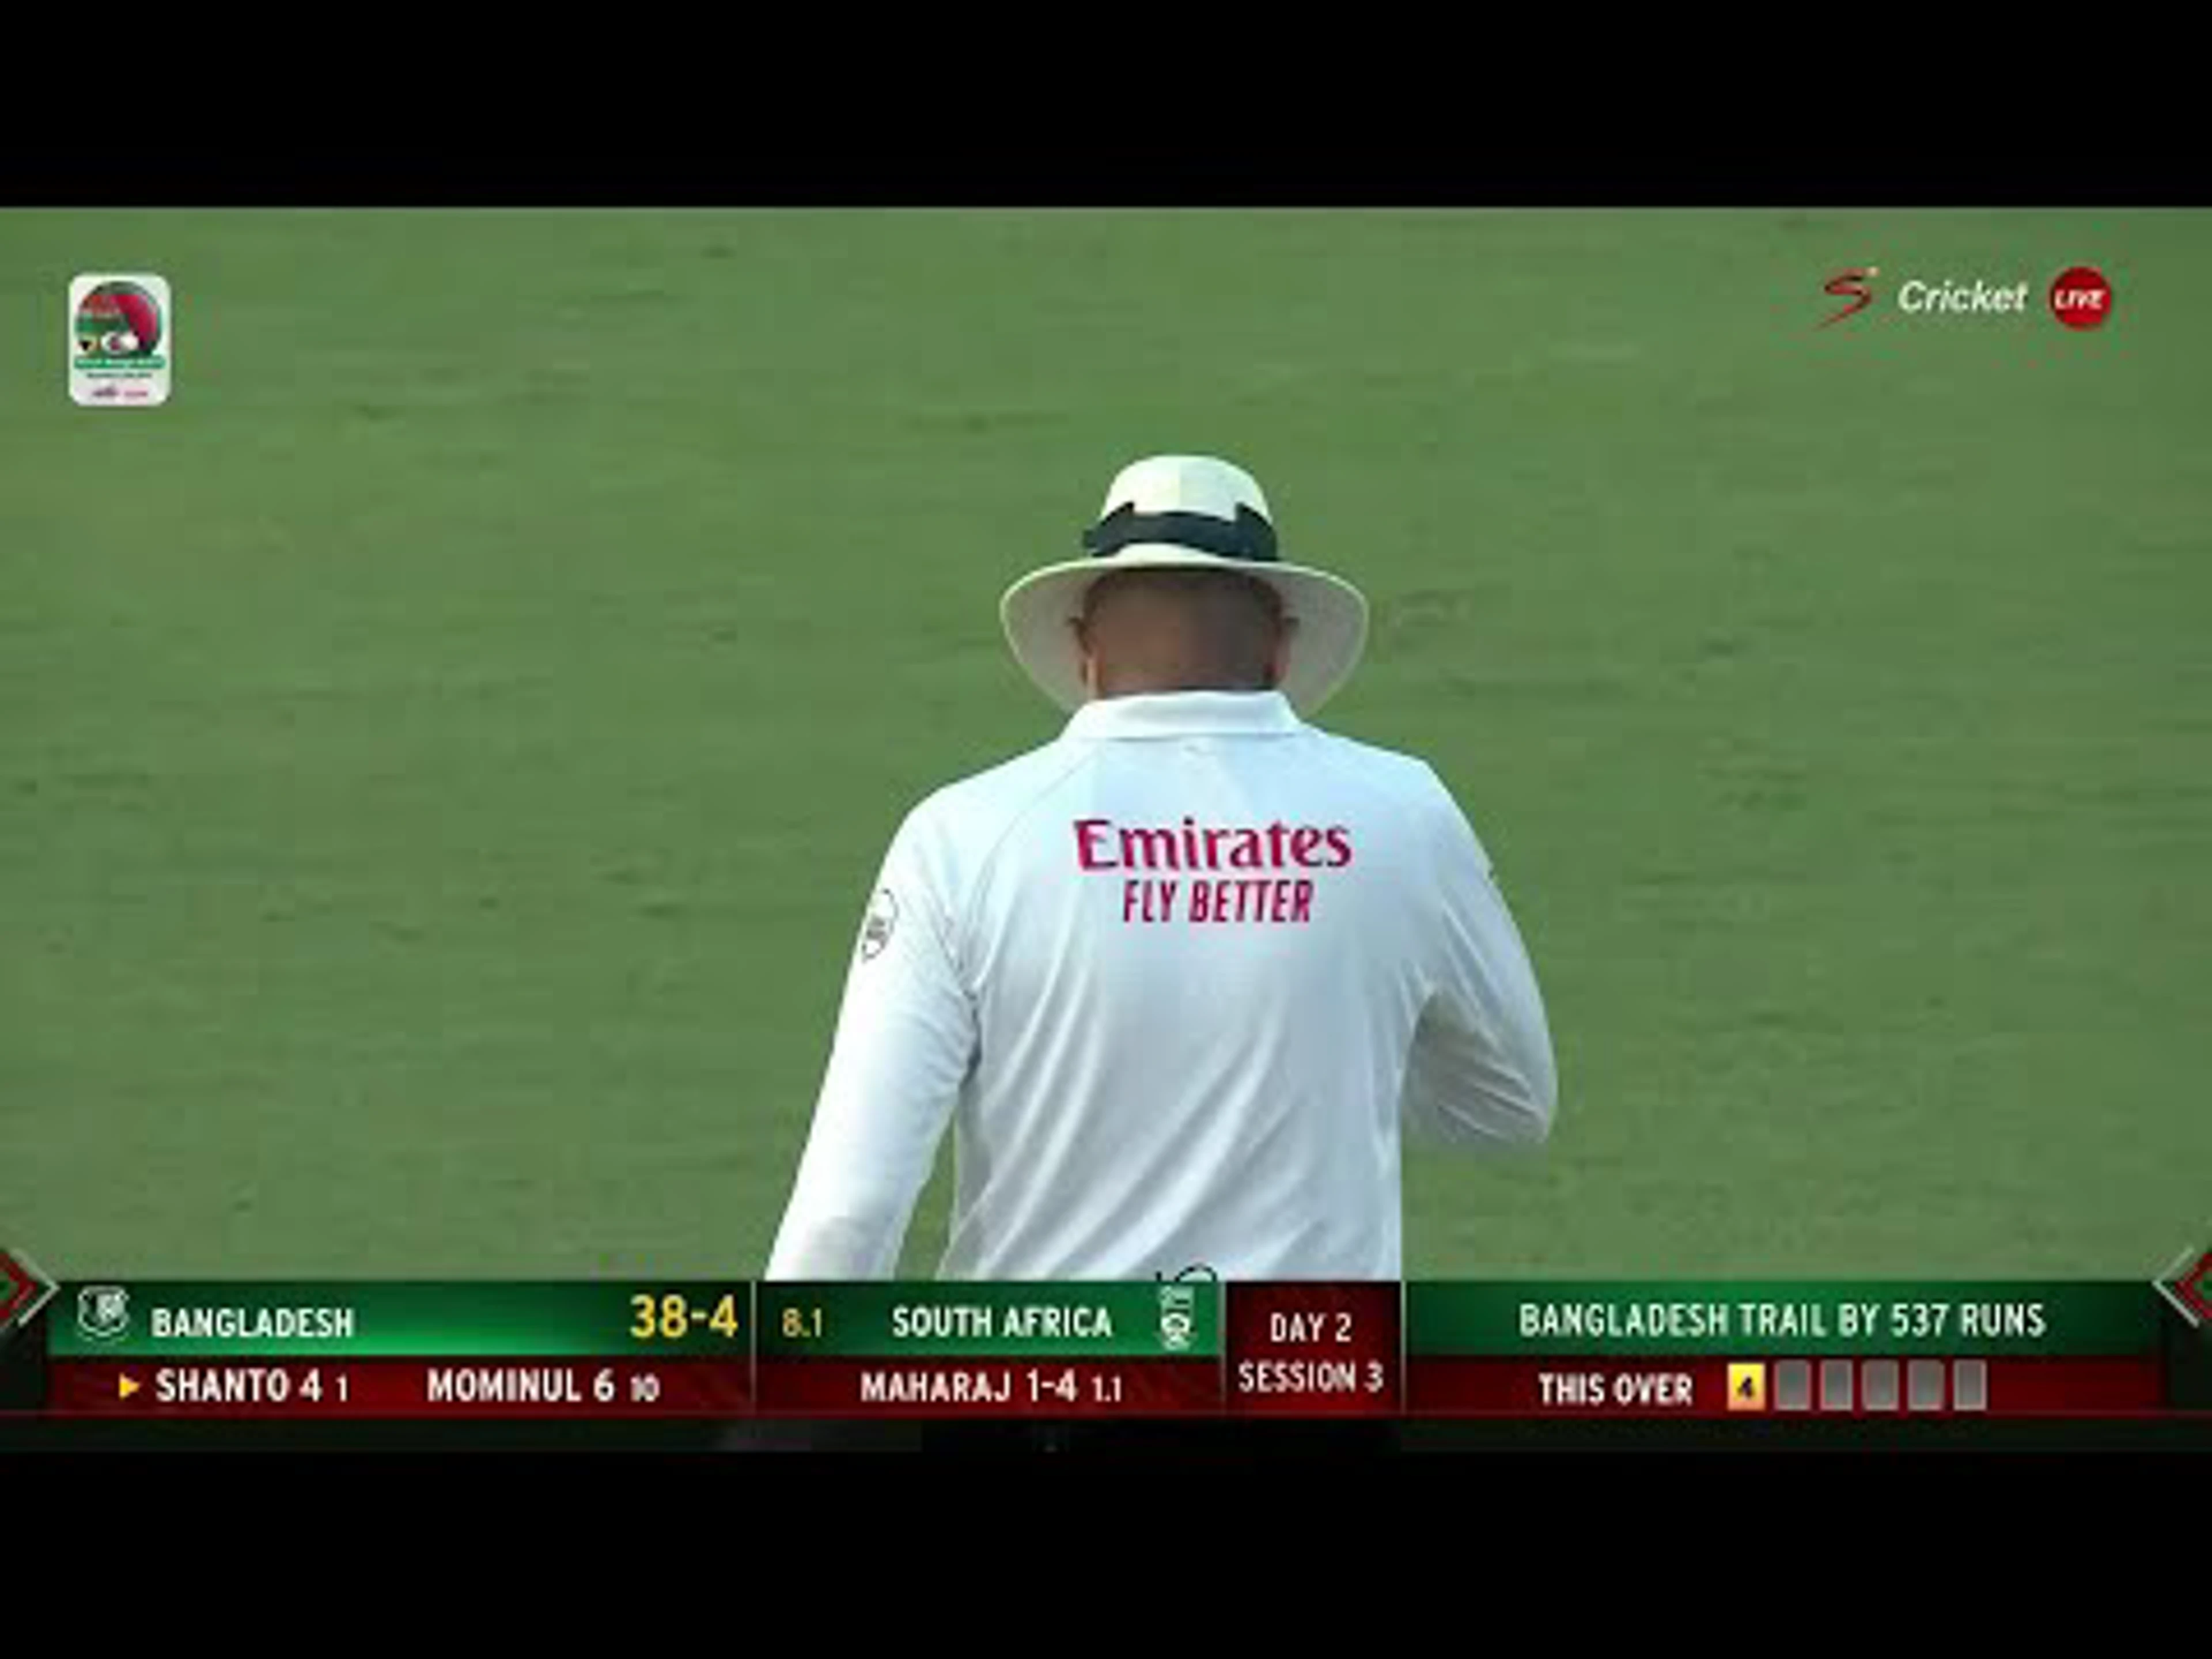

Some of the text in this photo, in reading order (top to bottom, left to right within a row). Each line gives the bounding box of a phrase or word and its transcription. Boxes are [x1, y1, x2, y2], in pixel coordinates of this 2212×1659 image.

[1074, 817, 1352, 870] Emirates
[1123, 880, 1313, 923] FLY BETTER
